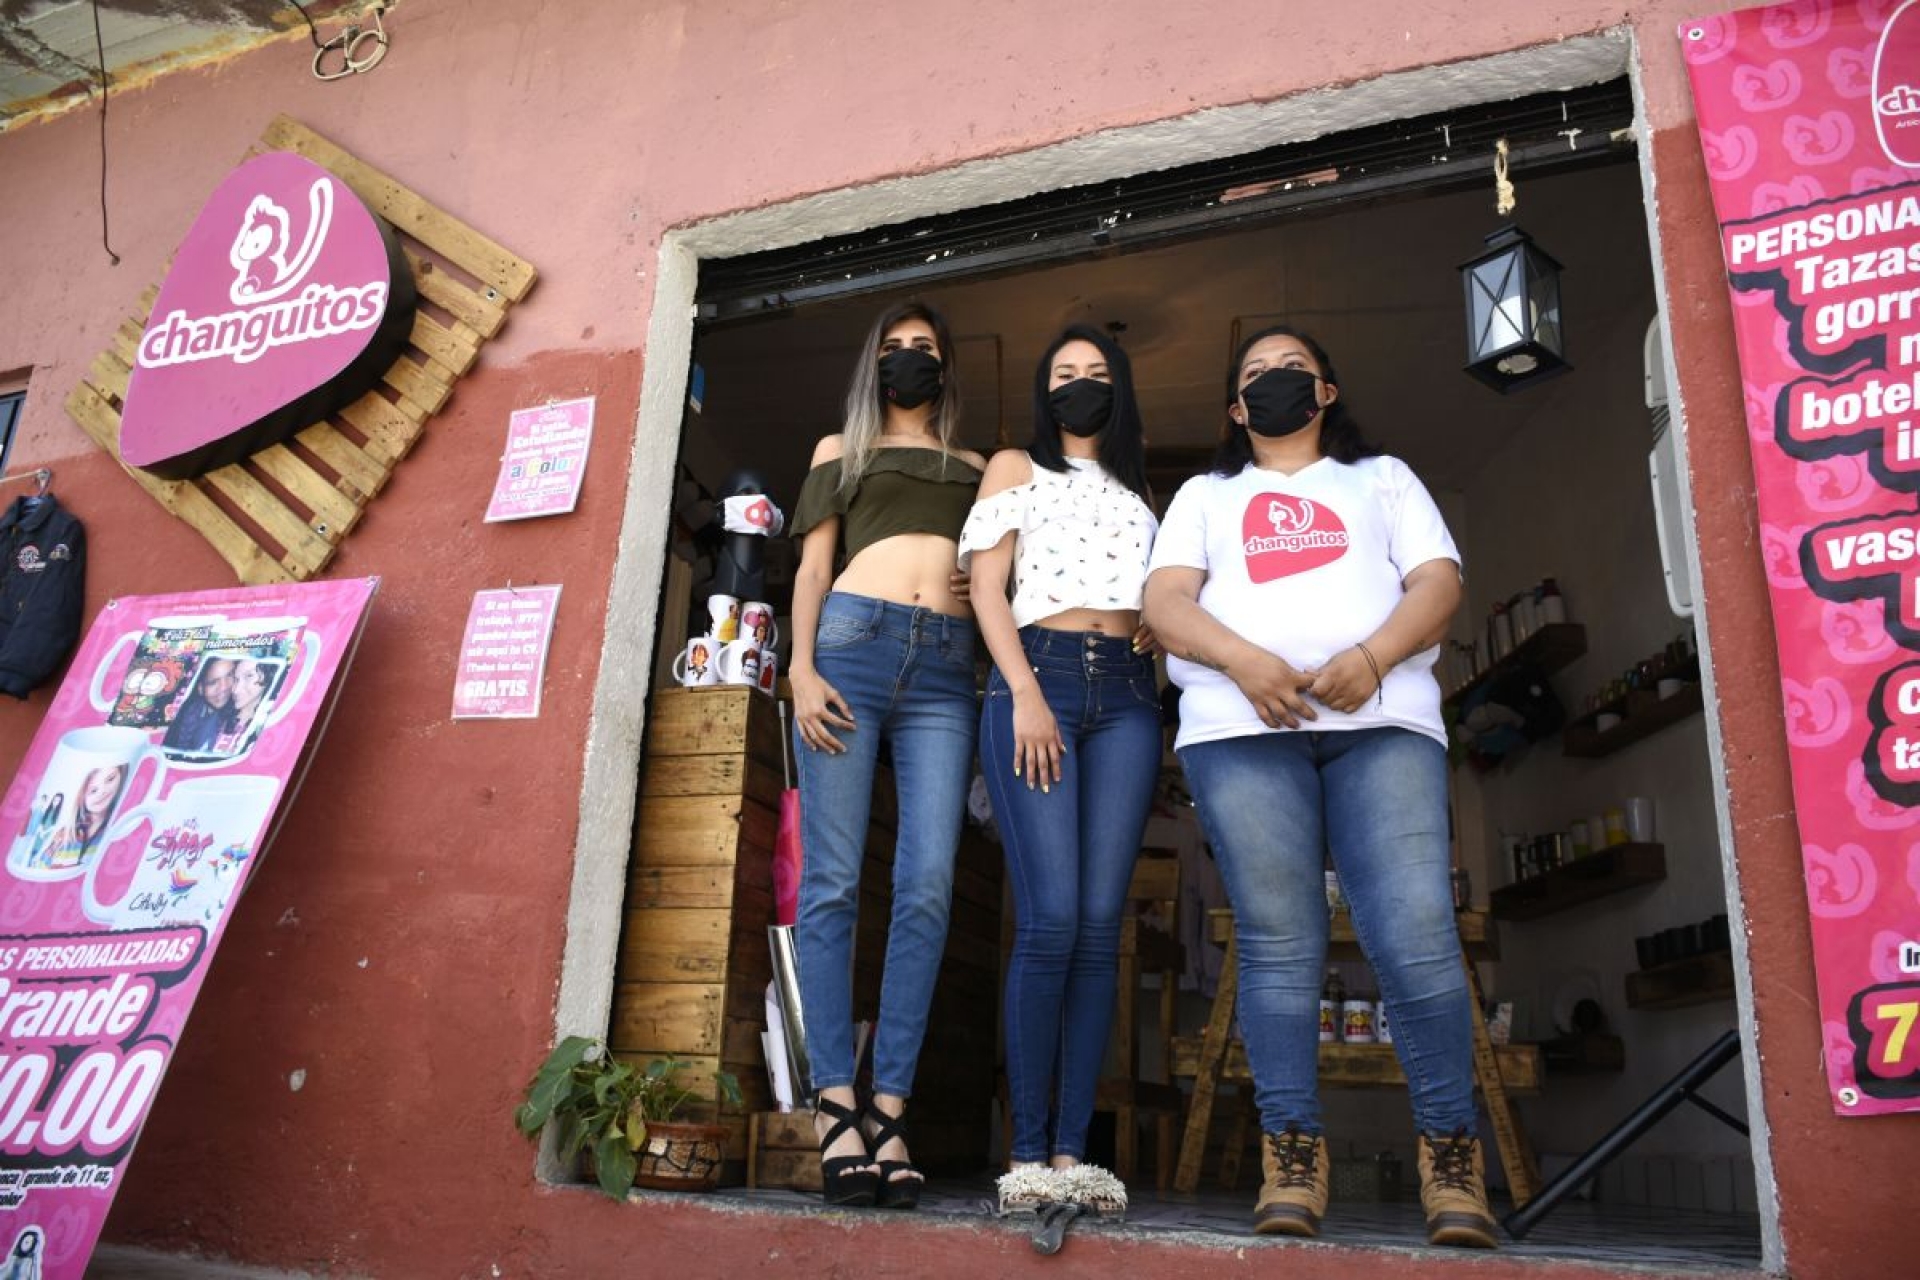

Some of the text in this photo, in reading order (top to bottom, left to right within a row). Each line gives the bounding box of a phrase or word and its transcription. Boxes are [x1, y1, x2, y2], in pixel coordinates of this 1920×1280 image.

[1731, 196, 1920, 265] PERSONA
[141, 286, 382, 362] changuitos
[1245, 532, 1347, 553] changuitos
[1826, 527, 1920, 570] vas
[17, 935, 195, 971] PERSONALIZADAS
[1877, 1003, 1919, 1063] 7
[0, 1050, 164, 1146] 0.00
